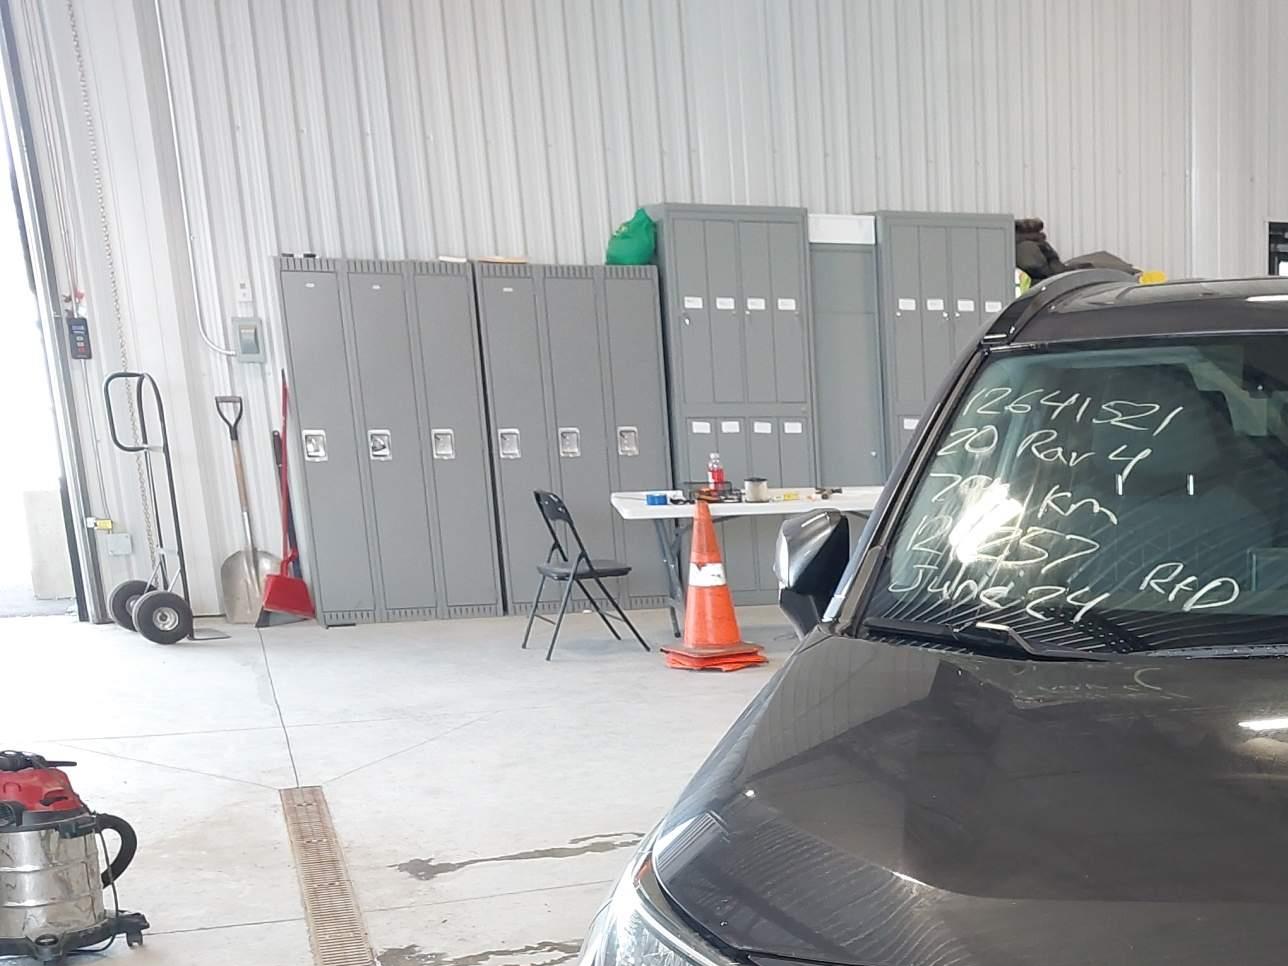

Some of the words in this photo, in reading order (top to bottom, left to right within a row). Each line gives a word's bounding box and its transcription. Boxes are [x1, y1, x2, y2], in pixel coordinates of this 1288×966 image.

[962, 386, 1183, 437] 12641521
[936, 424, 998, 457] 20
[1015, 429, 1096, 467] Rav
[1107, 444, 1153, 484] 4
[1025, 585, 1111, 623] 24
